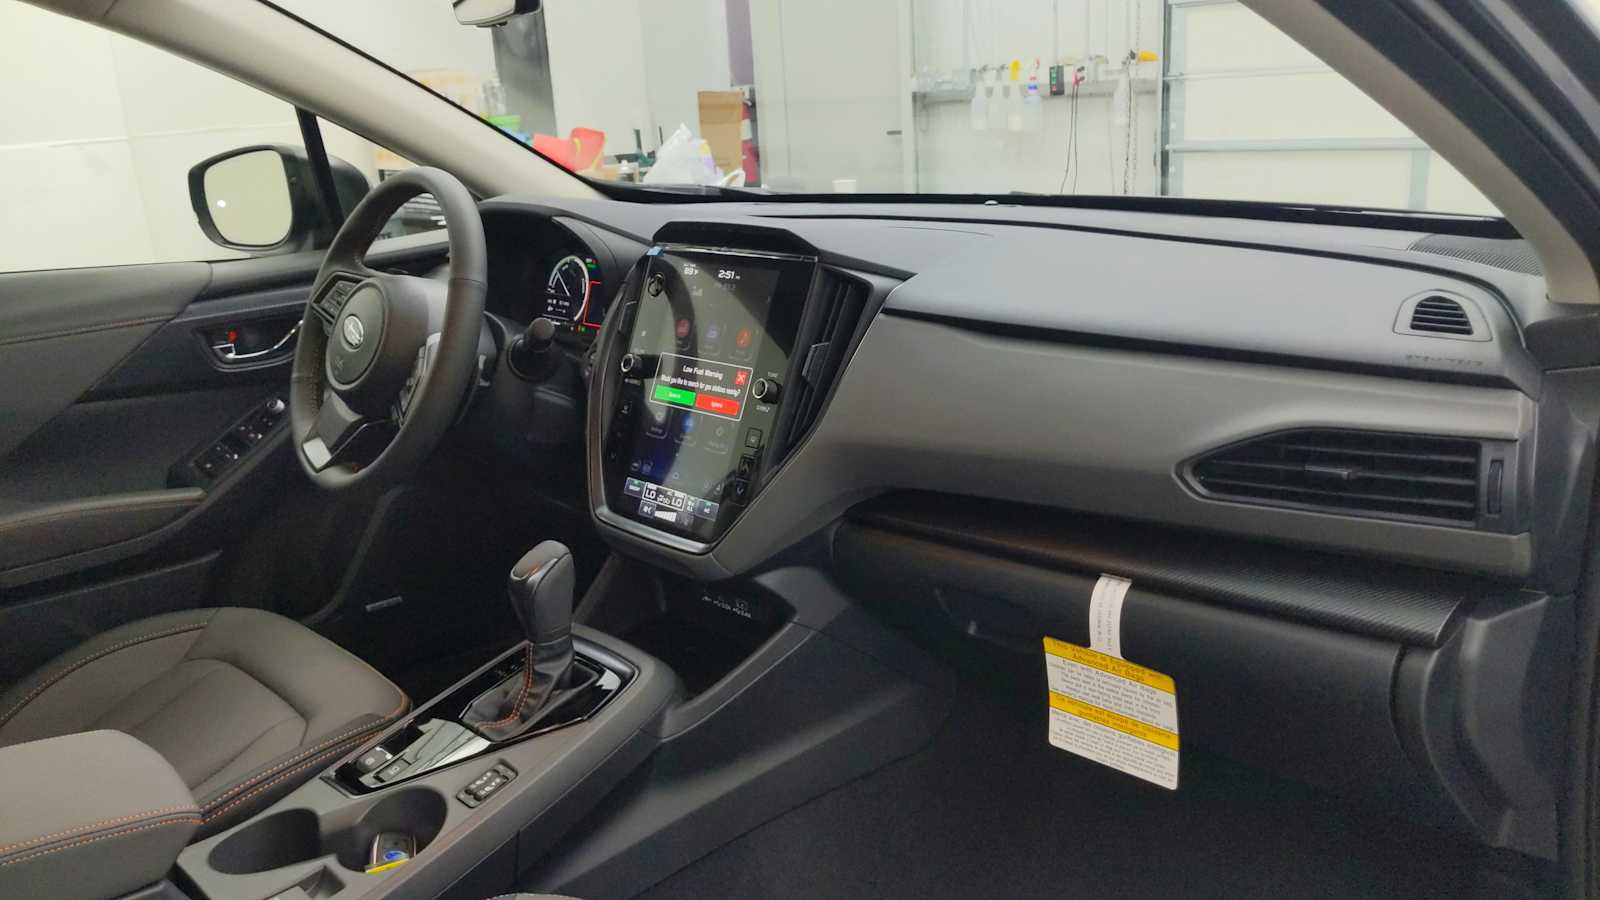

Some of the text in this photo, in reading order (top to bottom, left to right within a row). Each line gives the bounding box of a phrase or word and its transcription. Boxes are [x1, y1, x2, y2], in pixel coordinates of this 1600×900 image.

[718, 269, 735, 279] 2:51
[682, 365, 724, 380] Low Fuel Warning
[645, 489, 657, 499] LO
[671, 497, 683, 508] LO
